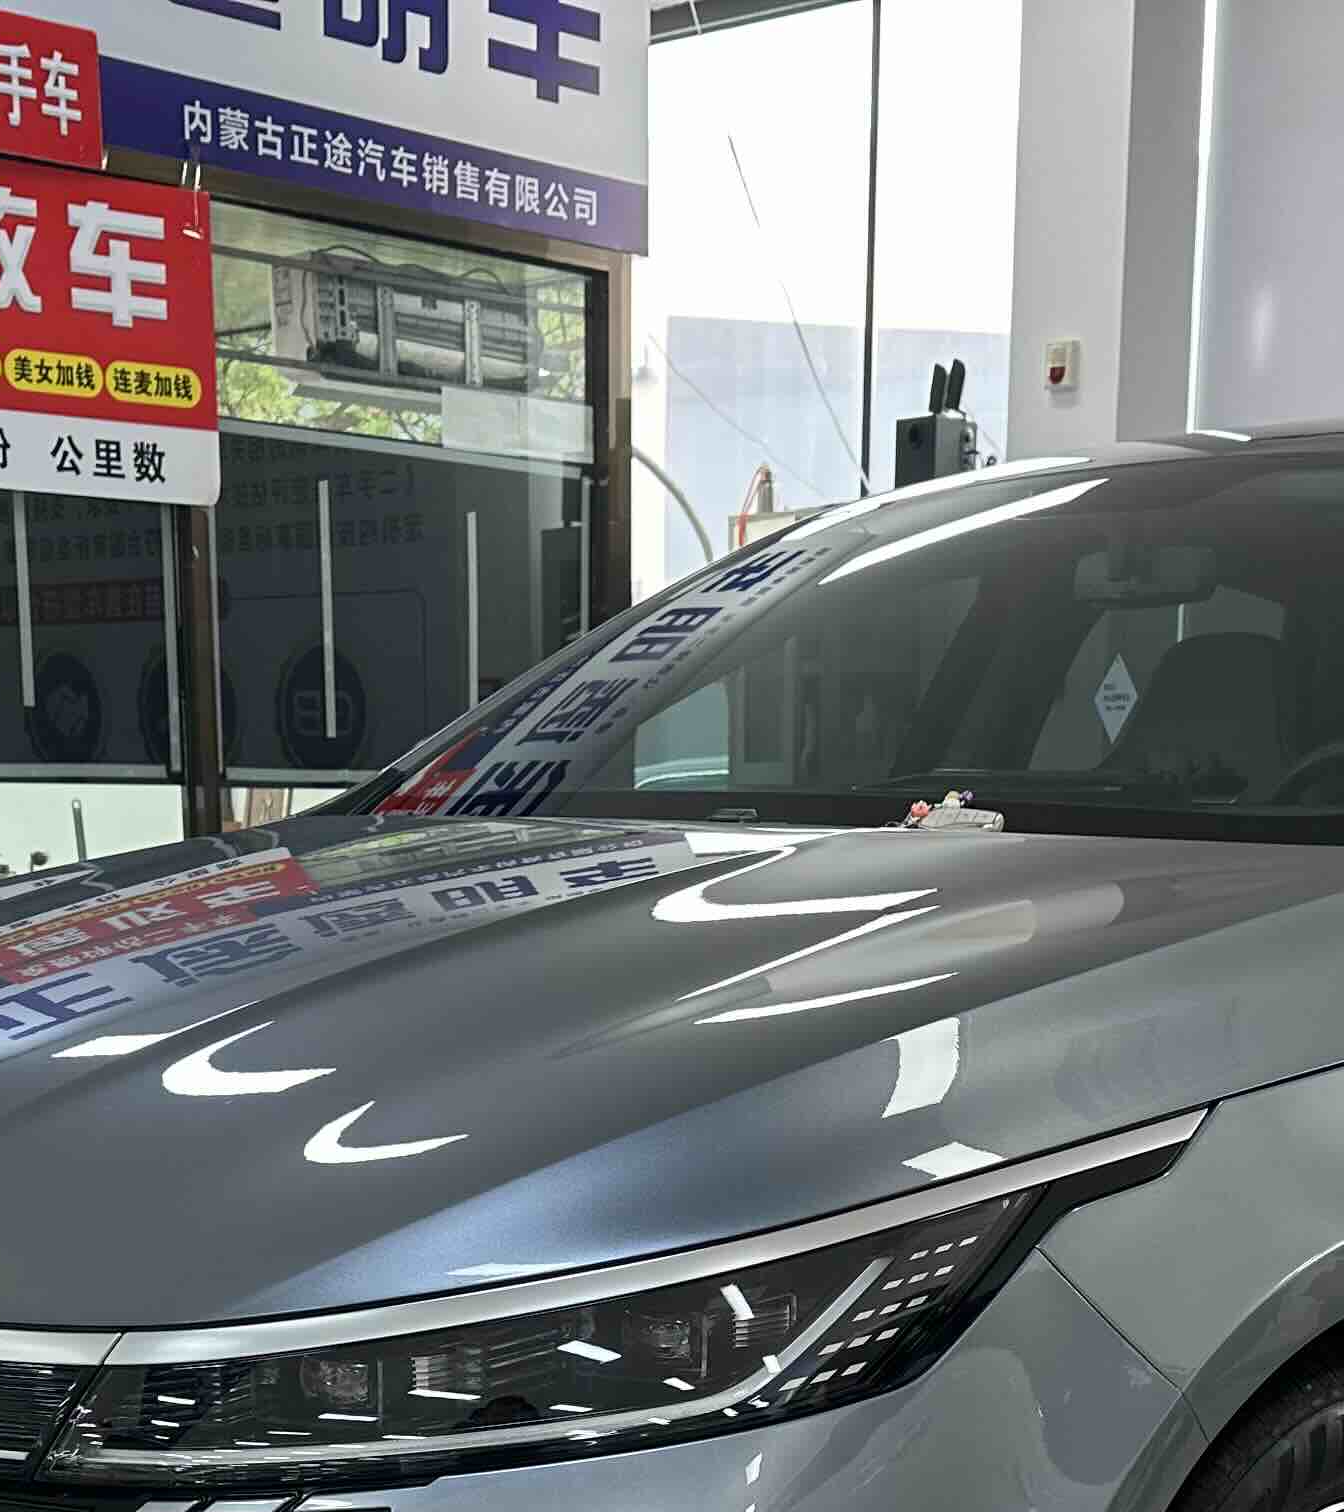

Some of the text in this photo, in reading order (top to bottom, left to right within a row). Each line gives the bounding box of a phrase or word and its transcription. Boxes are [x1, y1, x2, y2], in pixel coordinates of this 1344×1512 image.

[183, 100, 598, 226] 内蒙古正途汽车销售有限公司
[13, 356, 96, 390] 美女加钱
[112, 367, 193, 401] 连麦加钱
[51, 435, 166, 483] 公里数
